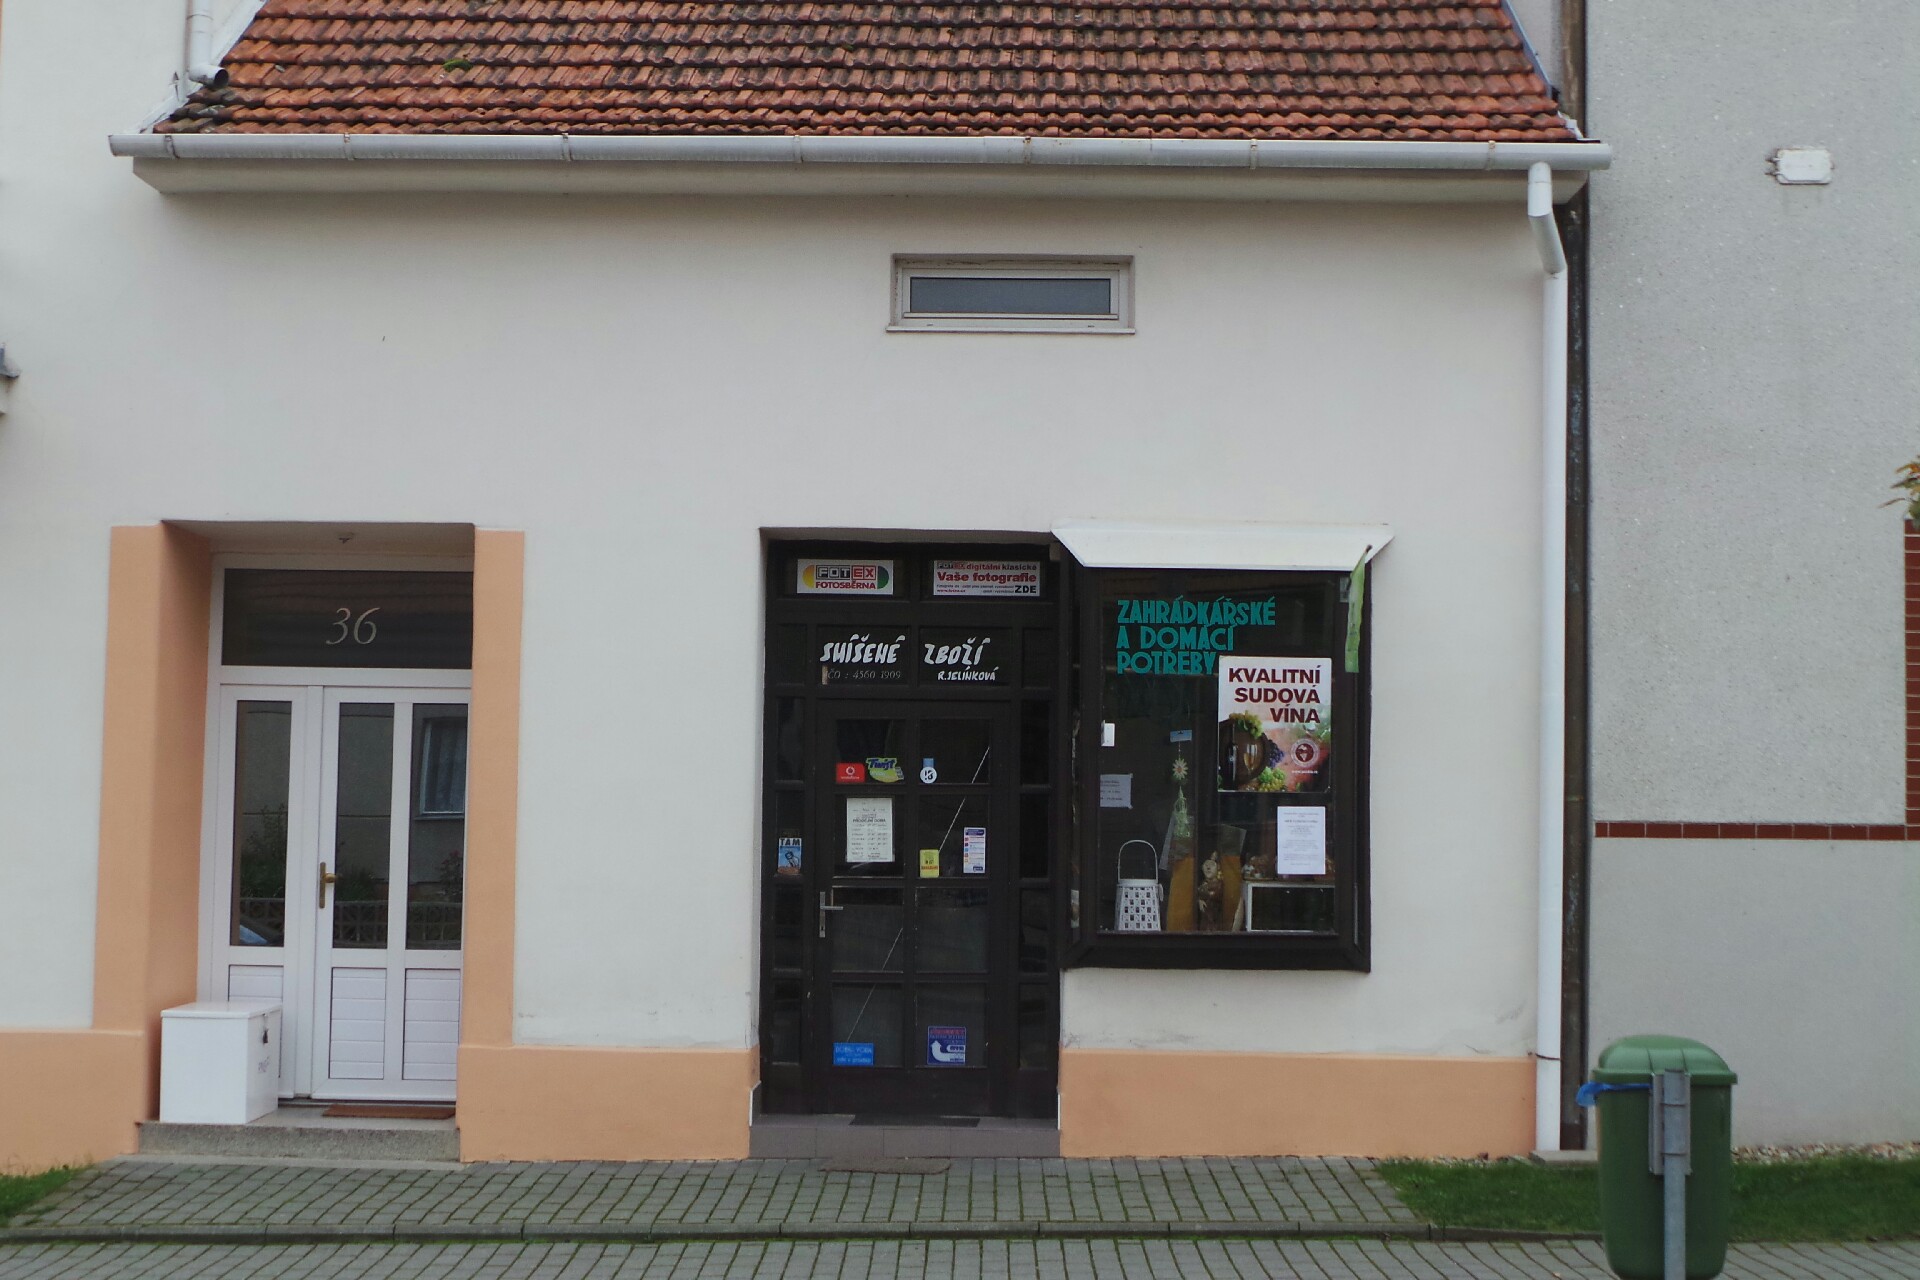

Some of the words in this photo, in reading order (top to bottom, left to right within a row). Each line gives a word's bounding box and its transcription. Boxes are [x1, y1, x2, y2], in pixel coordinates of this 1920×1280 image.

[815, 565, 876, 580] FOTEX
[937, 570, 969, 582] Vaše
[972, 571, 1037, 588] fotografie
[815, 579, 876, 590] FOTOSBĚRNA
[1014, 585, 1037, 594] ZDE
[1117, 596, 1276, 626] ZAHRÁDKÁŘSKÉ
[325, 607, 380, 645] 36
[1116, 625, 1130, 649] A
[1140, 622, 1238, 651] DOMÁCÍ
[924, 637, 991, 665] ZBOŽÍ
[1117, 648, 1218, 676] POTŘEBY
[852, 670, 876, 680] 4560
[1228, 664, 1321, 684] KVALITNÍ
[1234, 684, 1321, 704] SUDOVÁ
[1269, 703, 1321, 724] VÍNA
